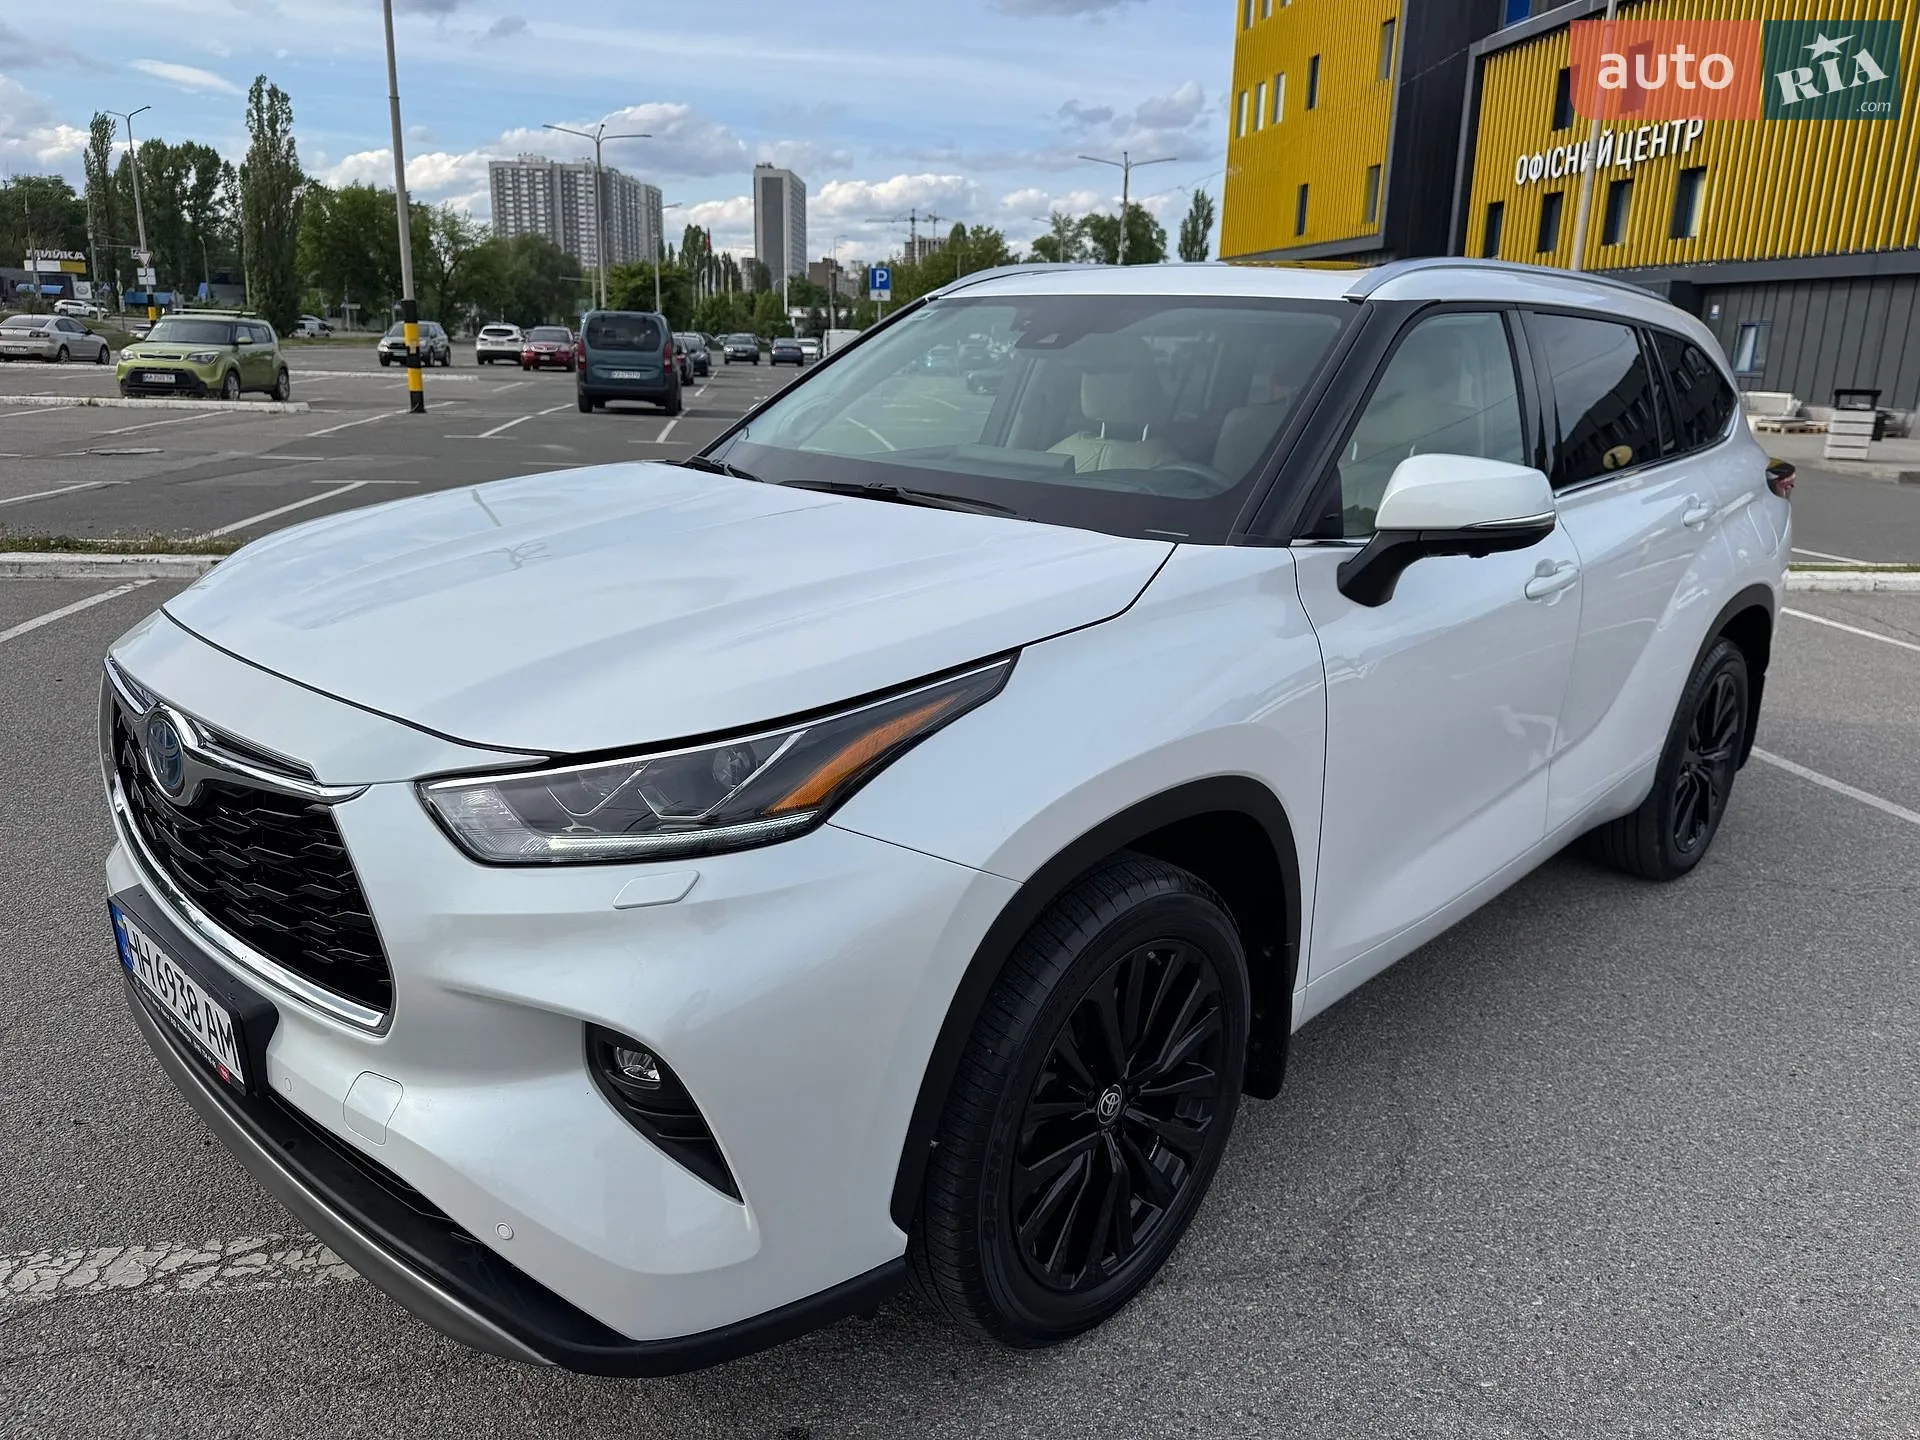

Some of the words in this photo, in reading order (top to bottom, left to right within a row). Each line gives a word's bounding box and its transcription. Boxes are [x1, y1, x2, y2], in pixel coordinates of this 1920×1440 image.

[1615, 117, 1704, 171] ЦЕНТР
[876, 270, 887, 287] P
[156, 953, 203, 1033] 6938
[204, 1000, 240, 1072] AM
